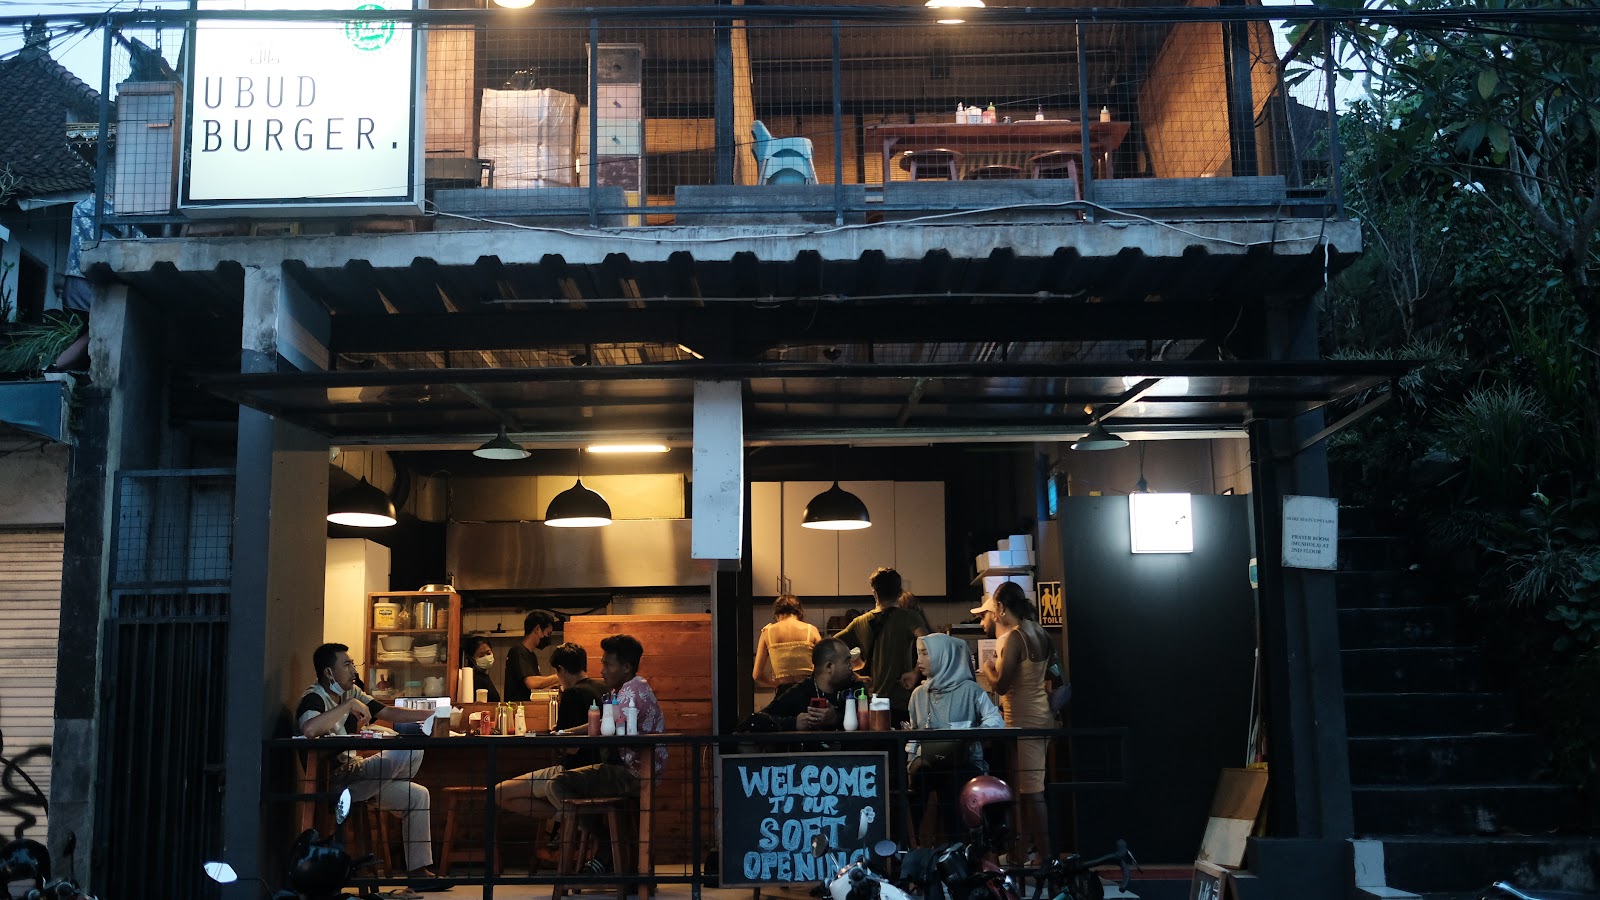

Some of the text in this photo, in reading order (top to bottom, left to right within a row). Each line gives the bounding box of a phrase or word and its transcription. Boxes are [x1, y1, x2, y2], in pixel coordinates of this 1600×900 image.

[204, 75, 316, 109] UBUD
[201, 117, 398, 153] BURGER.
[738, 763, 877, 798] WELCOME
[768, 795, 839, 815] TO OUR
[758, 815, 847, 852] SOFT
